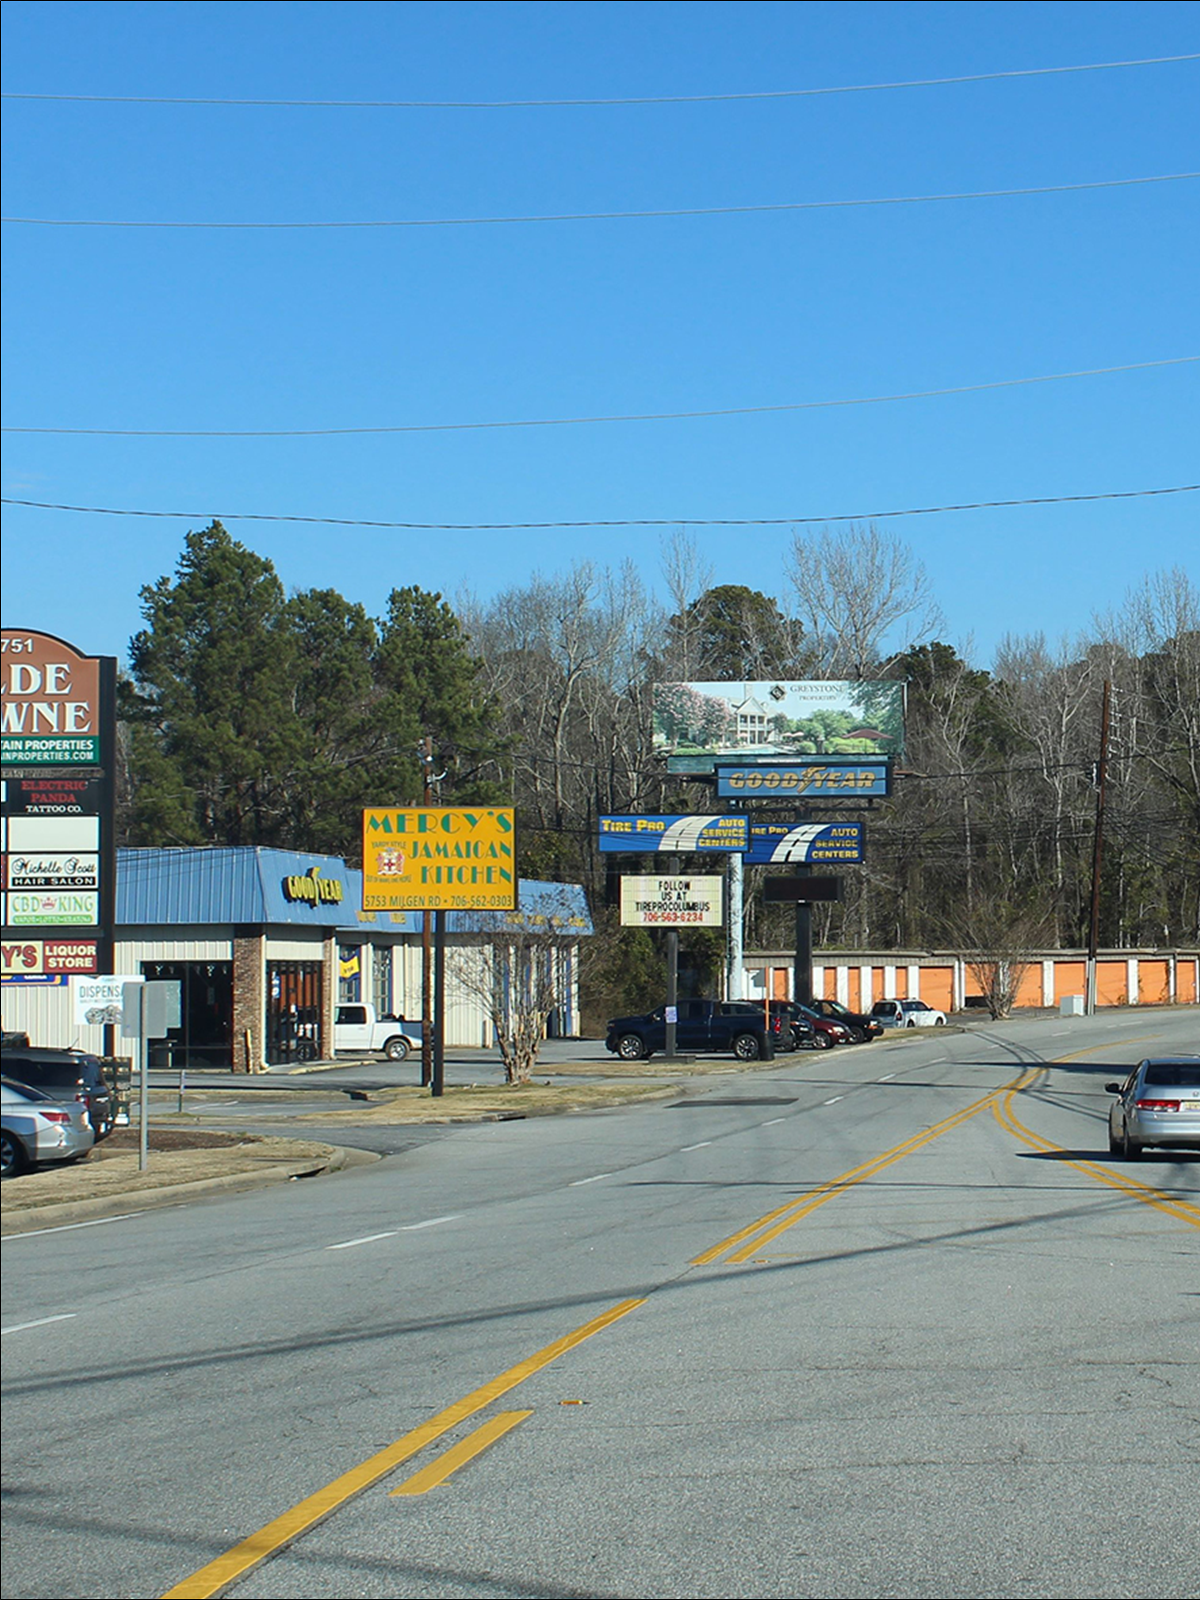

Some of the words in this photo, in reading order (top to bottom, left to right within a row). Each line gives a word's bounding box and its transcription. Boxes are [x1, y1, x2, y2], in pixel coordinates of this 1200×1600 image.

[1, 663, 72, 695] DE
[1, 740, 22, 750] AIN
[24, 740, 94, 750] PROPERTIES
[21, 780, 88, 790] ELECTRIC
[728, 766, 876, 794] GOODYEAR
[30, 793, 76, 803] PANDA
[25, 804, 66, 813] TATTOO
[67, 804, 83, 813] CO.
[366, 811, 512, 834] MERCY'S
[718, 818, 746, 827] AUTO
[702, 828, 746, 837] SERVICE
[830, 828, 858, 836] AUTO
[698, 838, 746, 847] CENTERS
[408, 840, 512, 859] JAMAICAN
[812, 850, 859, 858] CENTERS
[12, 856, 62, 875] Michelle
[420, 865, 512, 884] KITCHEN
[14, 876, 46, 885] HAIR
[50, 876, 94, 885] SALON
[658, 880, 690, 891] FOLLOW
[285, 868, 343, 905] GOODYEAR
[365, 896, 387, 907] 5753
[390, 896, 426, 907] MILGEN
[428, 896, 441, 907] RD
[450, 896, 512, 907] 706-562-0303
[661, 892, 672, 901] US
[676, 892, 687, 900] AT
[12, 896, 40, 912] CBD
[58, 896, 94, 912] KING
[636, 902, 710, 912] TIREPROCOLUMBUS
[643, 912, 704, 922] 706-563-6234
[45, 944, 96, 956] LIQUOR
[48, 957, 94, 968] STORE
[79, 984, 122, 998] DISPENS
